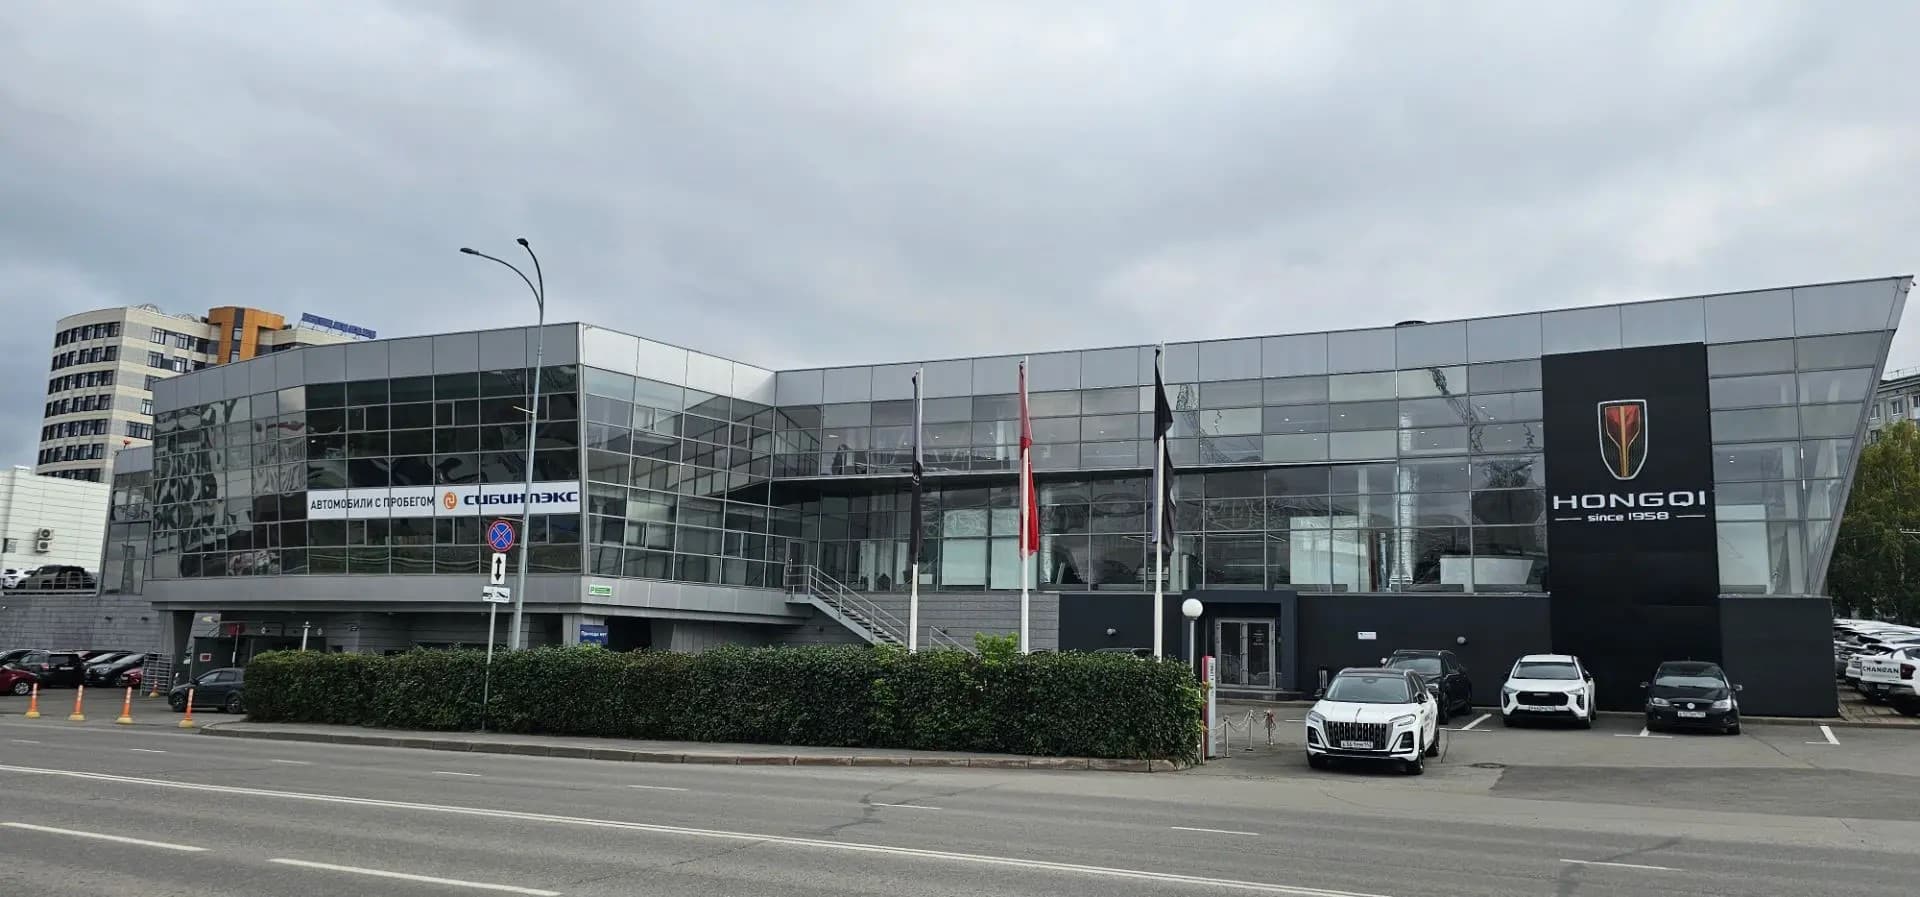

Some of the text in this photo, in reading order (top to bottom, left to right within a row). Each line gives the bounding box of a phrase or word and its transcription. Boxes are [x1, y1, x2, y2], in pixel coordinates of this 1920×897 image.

[310, 496, 434, 510] АВТОМОБИЛИ С ПРОБЕГОМ
[463, 491, 578, 505] СИБИНПЭКС
[1553, 491, 1706, 510] HONGQI
[1587, 512, 1670, 522] since 1958
